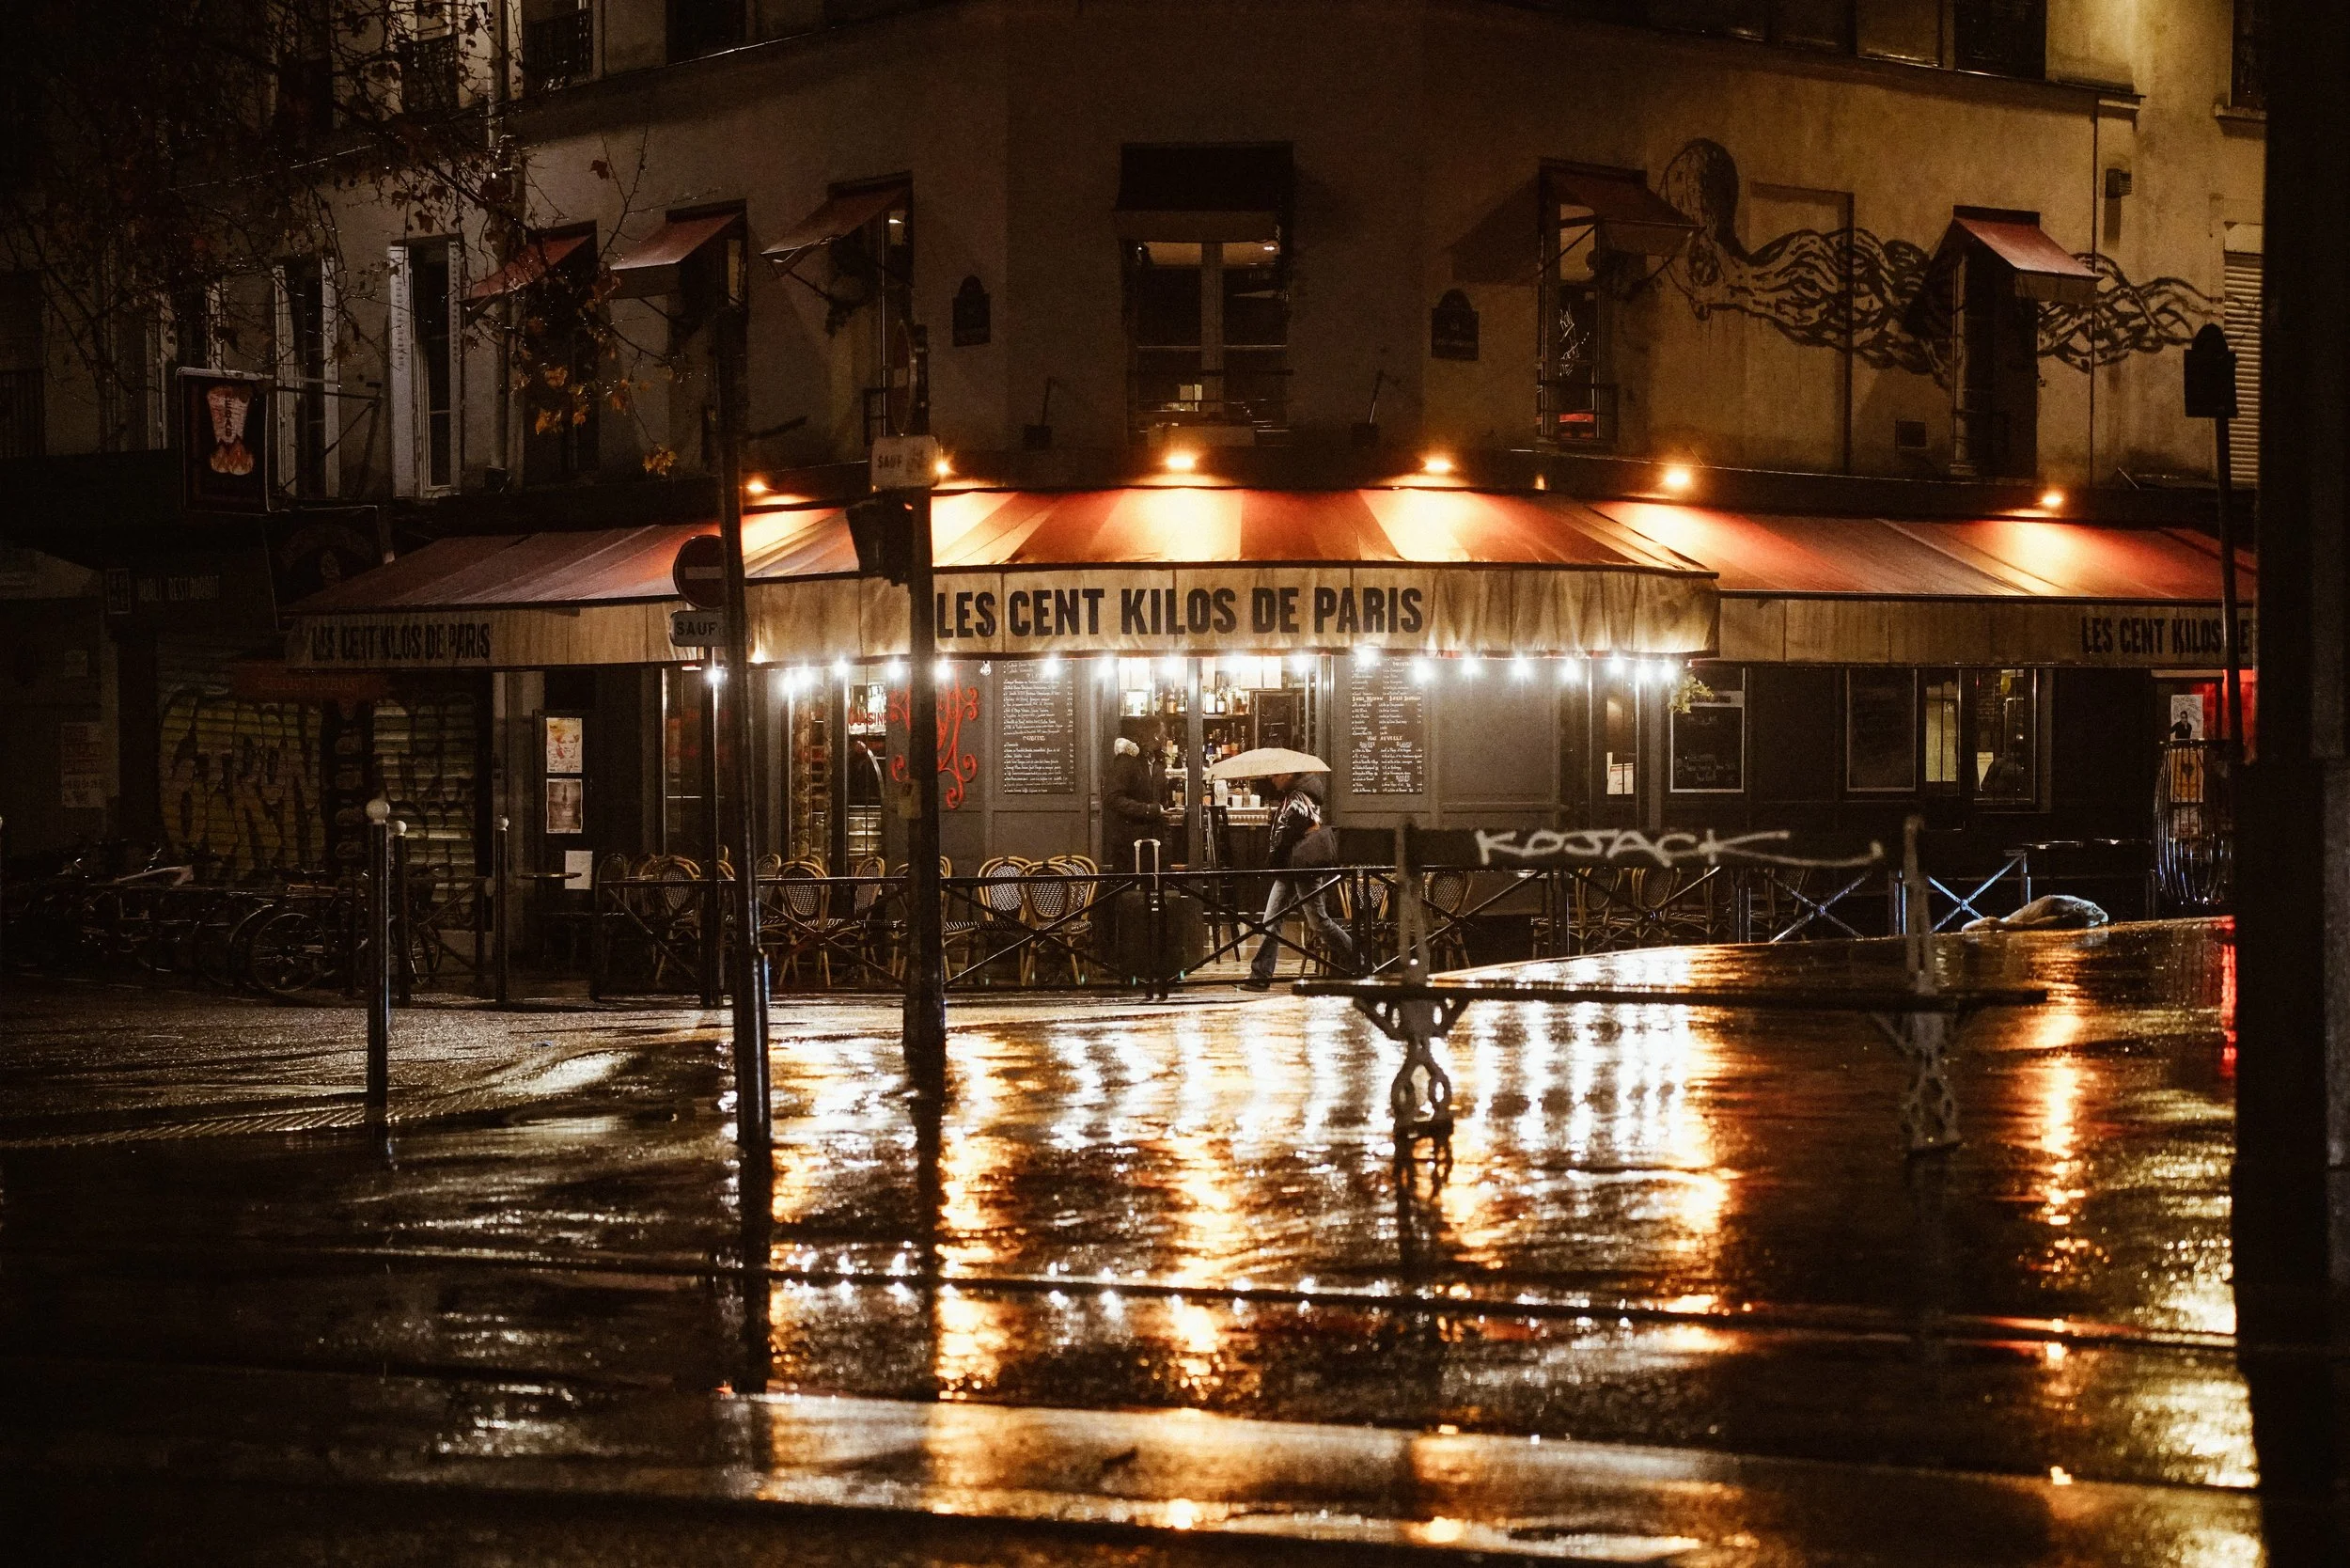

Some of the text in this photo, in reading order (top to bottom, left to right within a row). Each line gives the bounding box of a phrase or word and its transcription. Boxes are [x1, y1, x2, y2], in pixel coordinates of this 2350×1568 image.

[676, 621, 717, 635] SAUF
[937, 587, 1423, 638] LES CENT KILOS DE PARIS
[448, 622, 491, 658] PARIS
[2081, 617, 2114, 653] LES
[2119, 617, 2165, 654] CENT
[2171, 618, 2223, 654] KILOS
[1475, 828, 1882, 868] KOJACK
